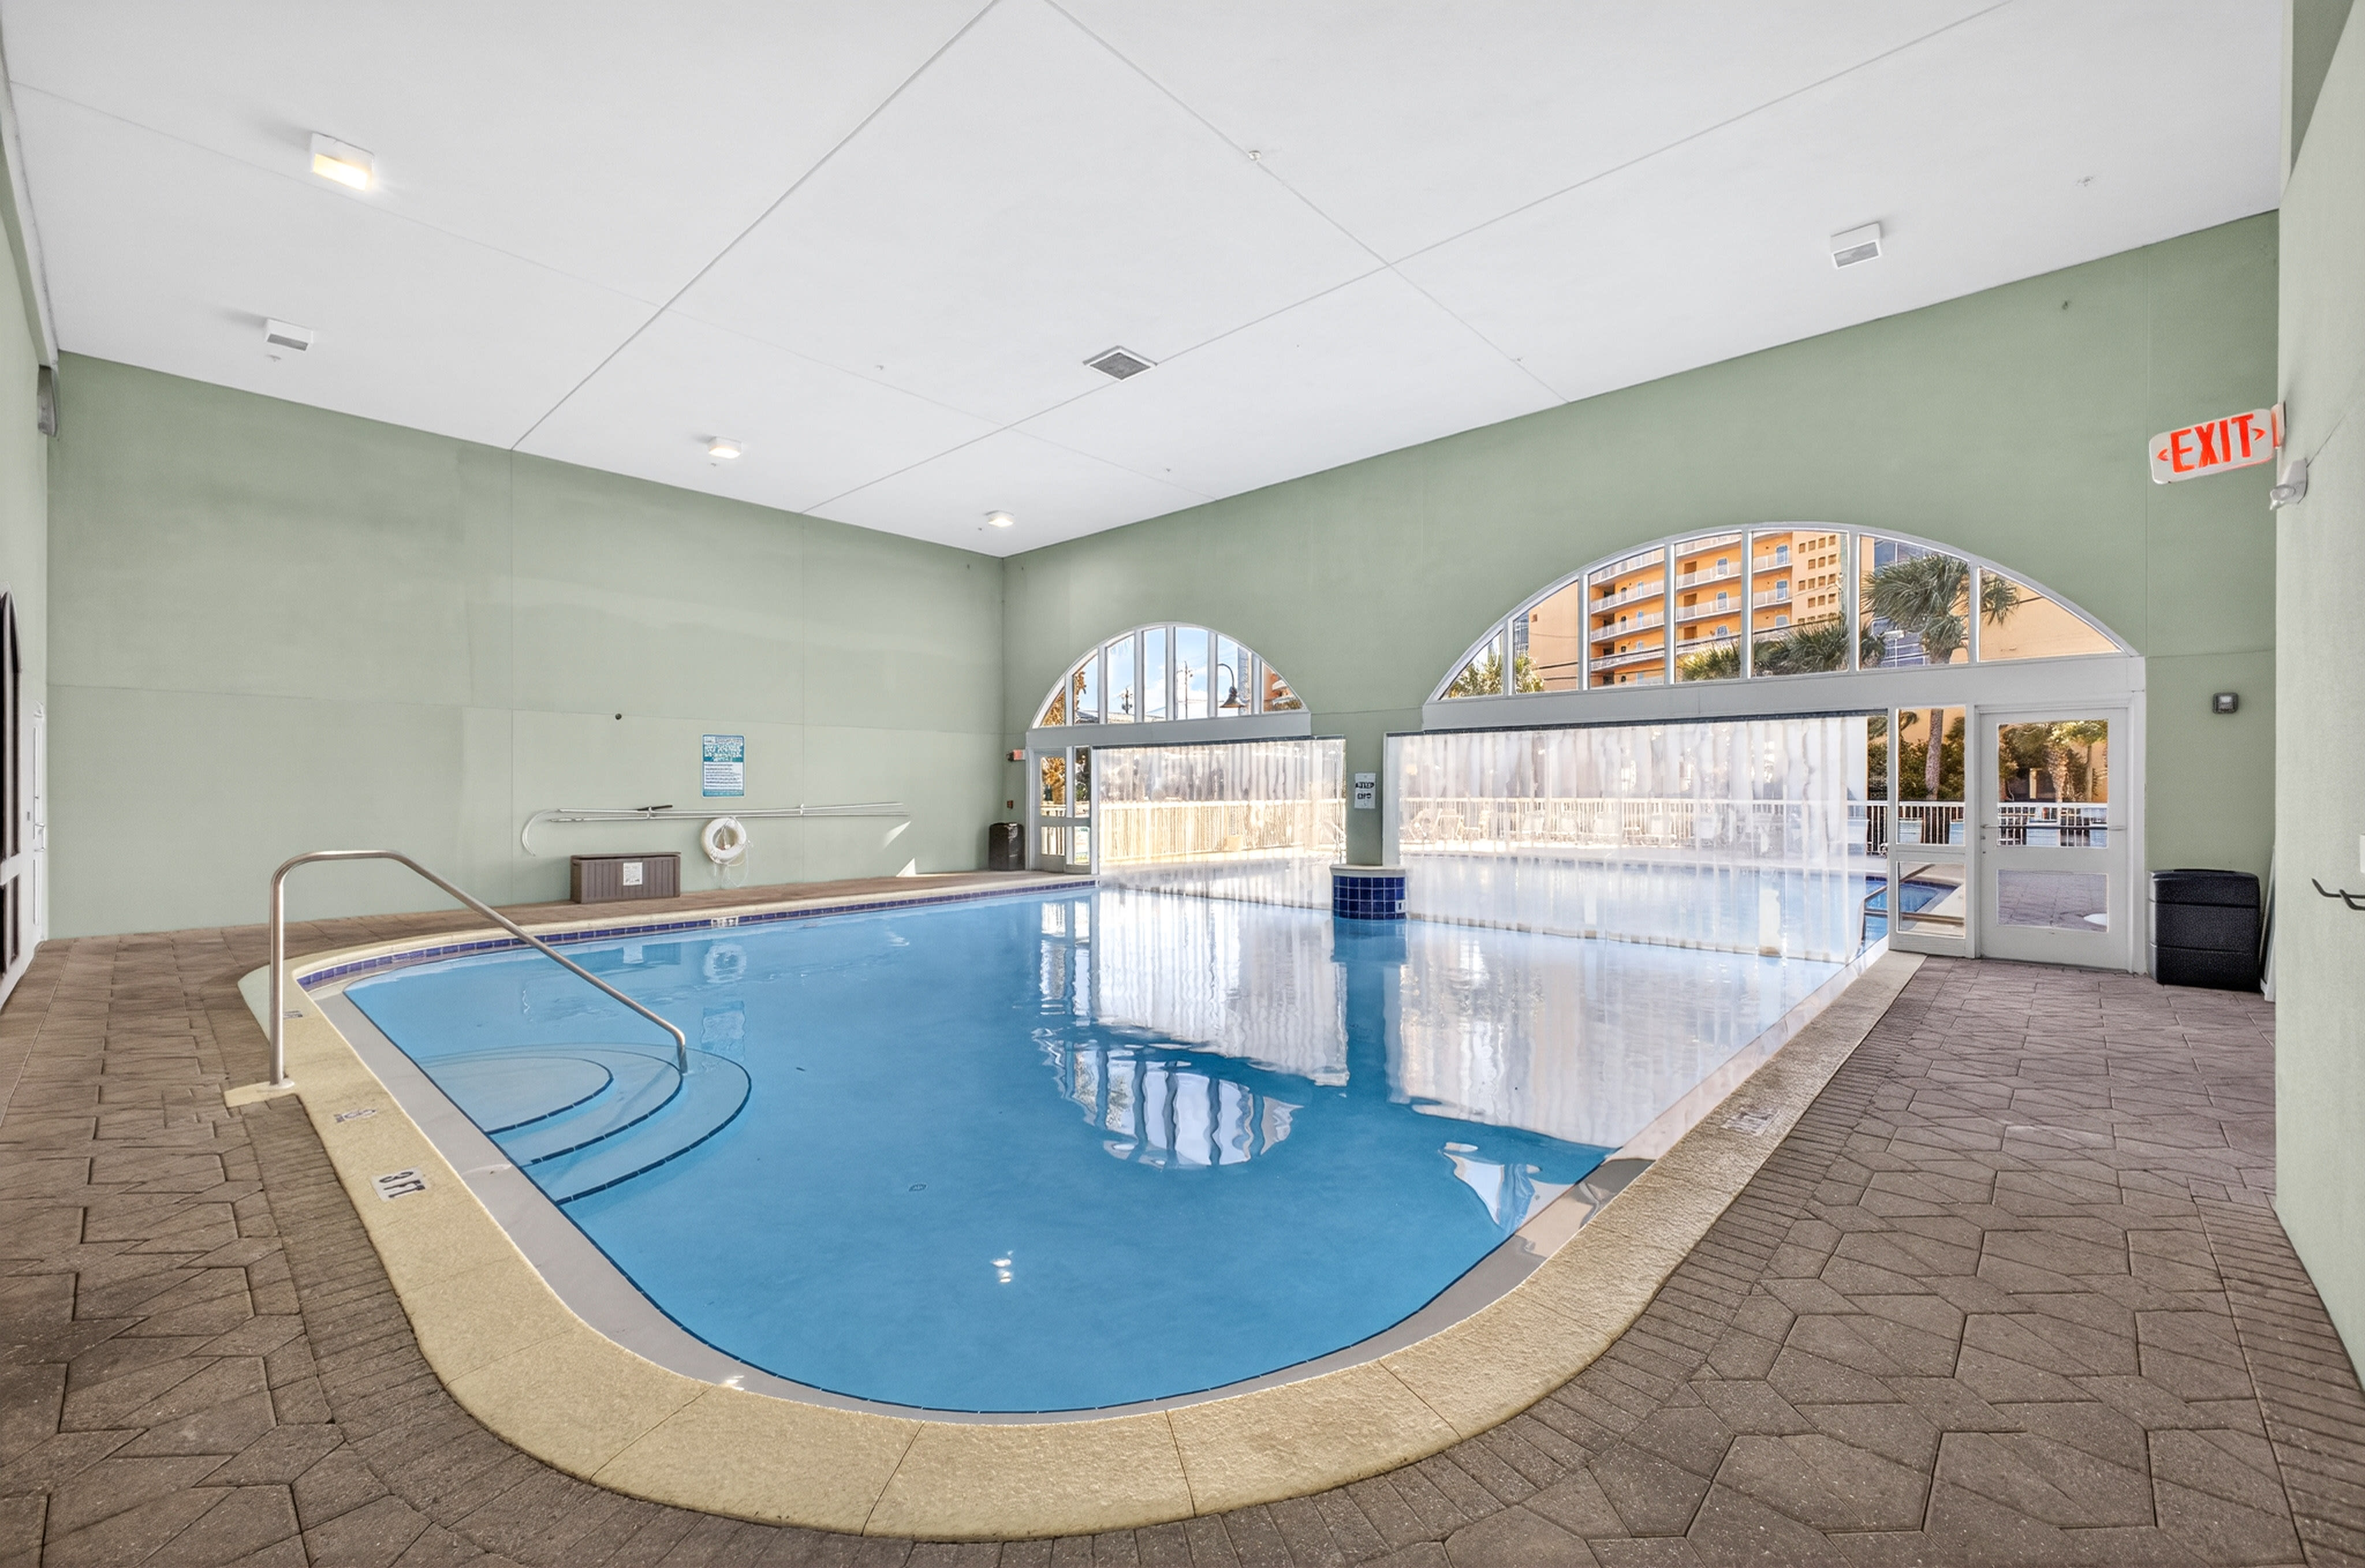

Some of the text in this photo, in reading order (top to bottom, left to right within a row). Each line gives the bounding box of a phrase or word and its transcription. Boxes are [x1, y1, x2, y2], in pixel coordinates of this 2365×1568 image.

[2170, 413, 2254, 473] EXIT
[378, 1171, 426, 1199] 3 FT
